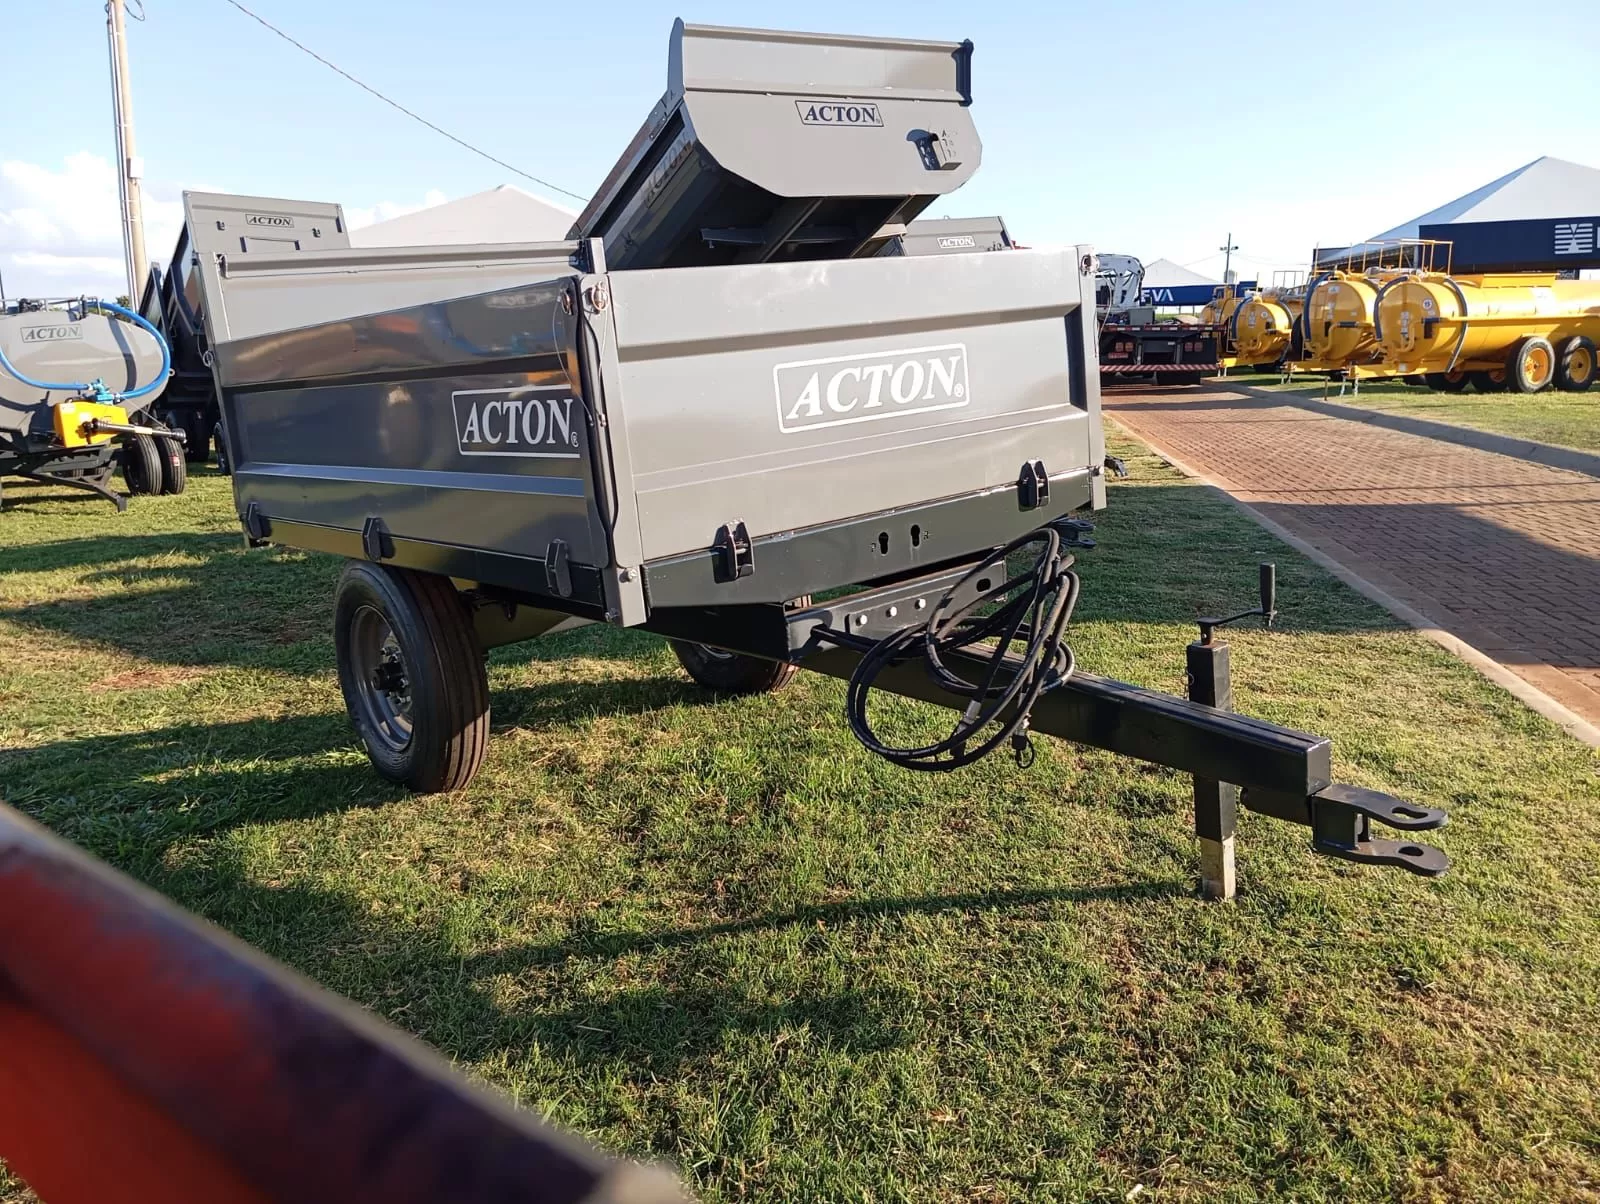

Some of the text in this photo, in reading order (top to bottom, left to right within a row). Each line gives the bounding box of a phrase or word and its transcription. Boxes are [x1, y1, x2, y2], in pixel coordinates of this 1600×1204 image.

[804, 105, 875, 122] ACTON
[249, 216, 291, 226] ACTON
[25, 327, 79, 340] ACTON
